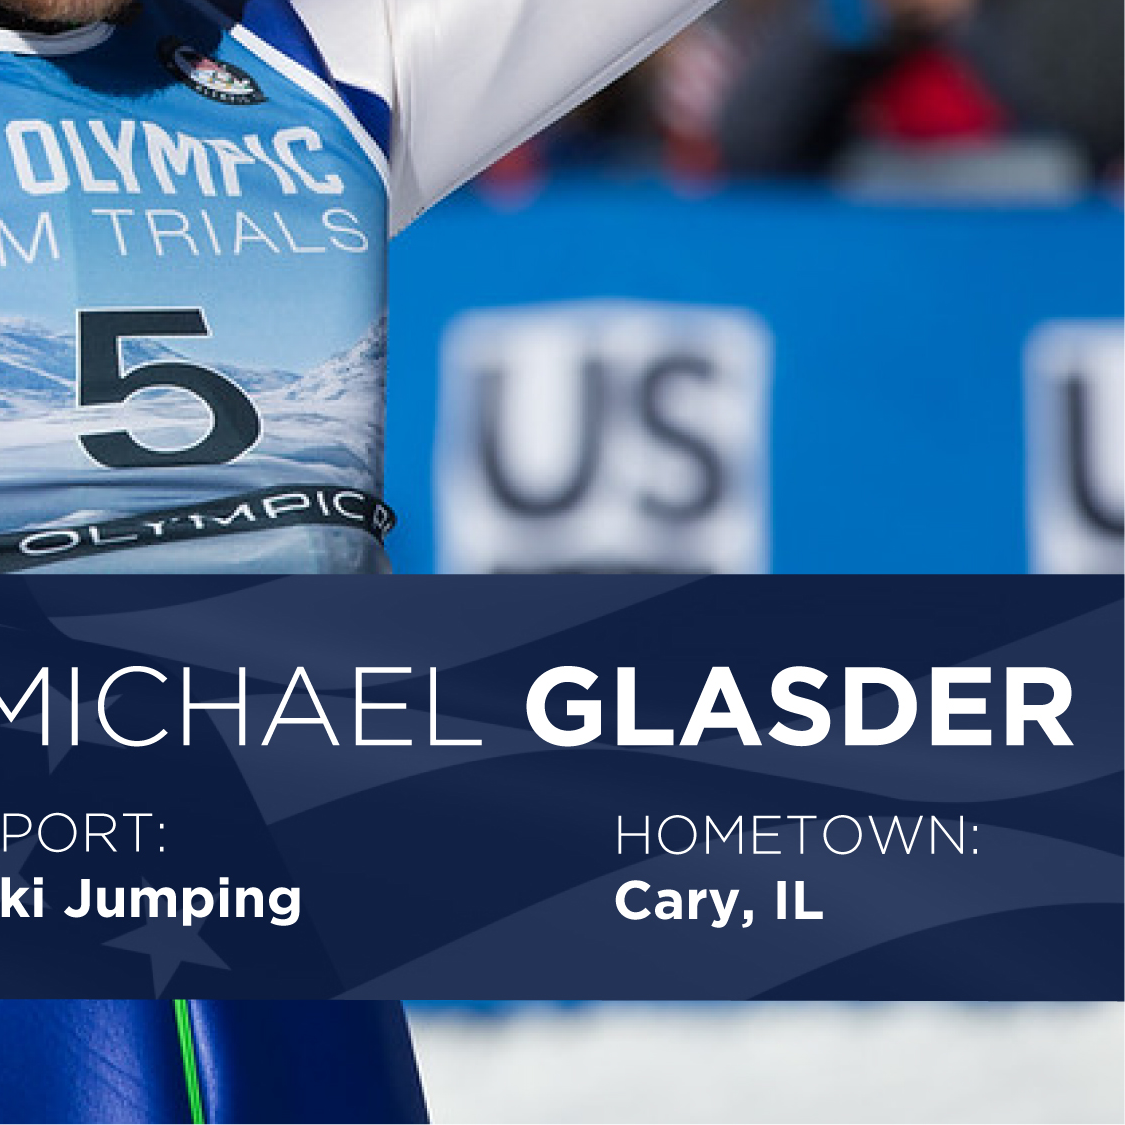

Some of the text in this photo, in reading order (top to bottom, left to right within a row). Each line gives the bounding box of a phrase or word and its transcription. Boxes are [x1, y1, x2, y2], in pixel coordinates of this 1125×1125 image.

[5, 119, 345, 197] OLYMPIC
[91, 209, 369, 256] TRIALS
[76, 306, 264, 470] 5
[473, 354, 729, 524] US
